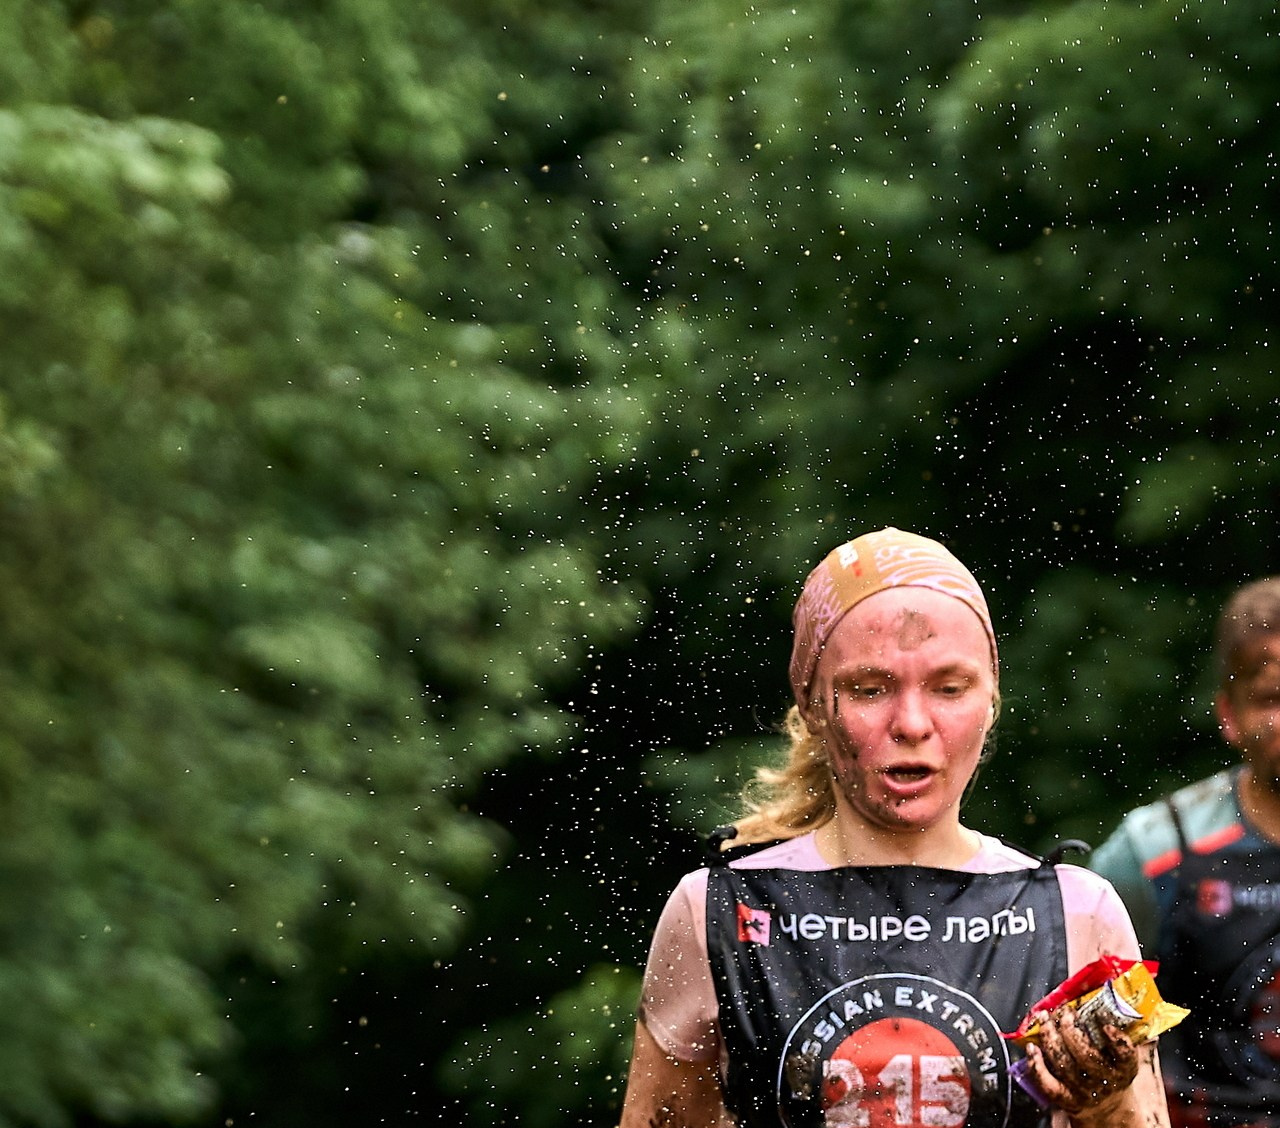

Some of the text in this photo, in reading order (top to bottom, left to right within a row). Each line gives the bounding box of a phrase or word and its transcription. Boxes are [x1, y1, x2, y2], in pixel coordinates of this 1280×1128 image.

[778, 907, 1036, 944] четыре лапы
[788, 985, 998, 1099] SSIAN EXTREME
